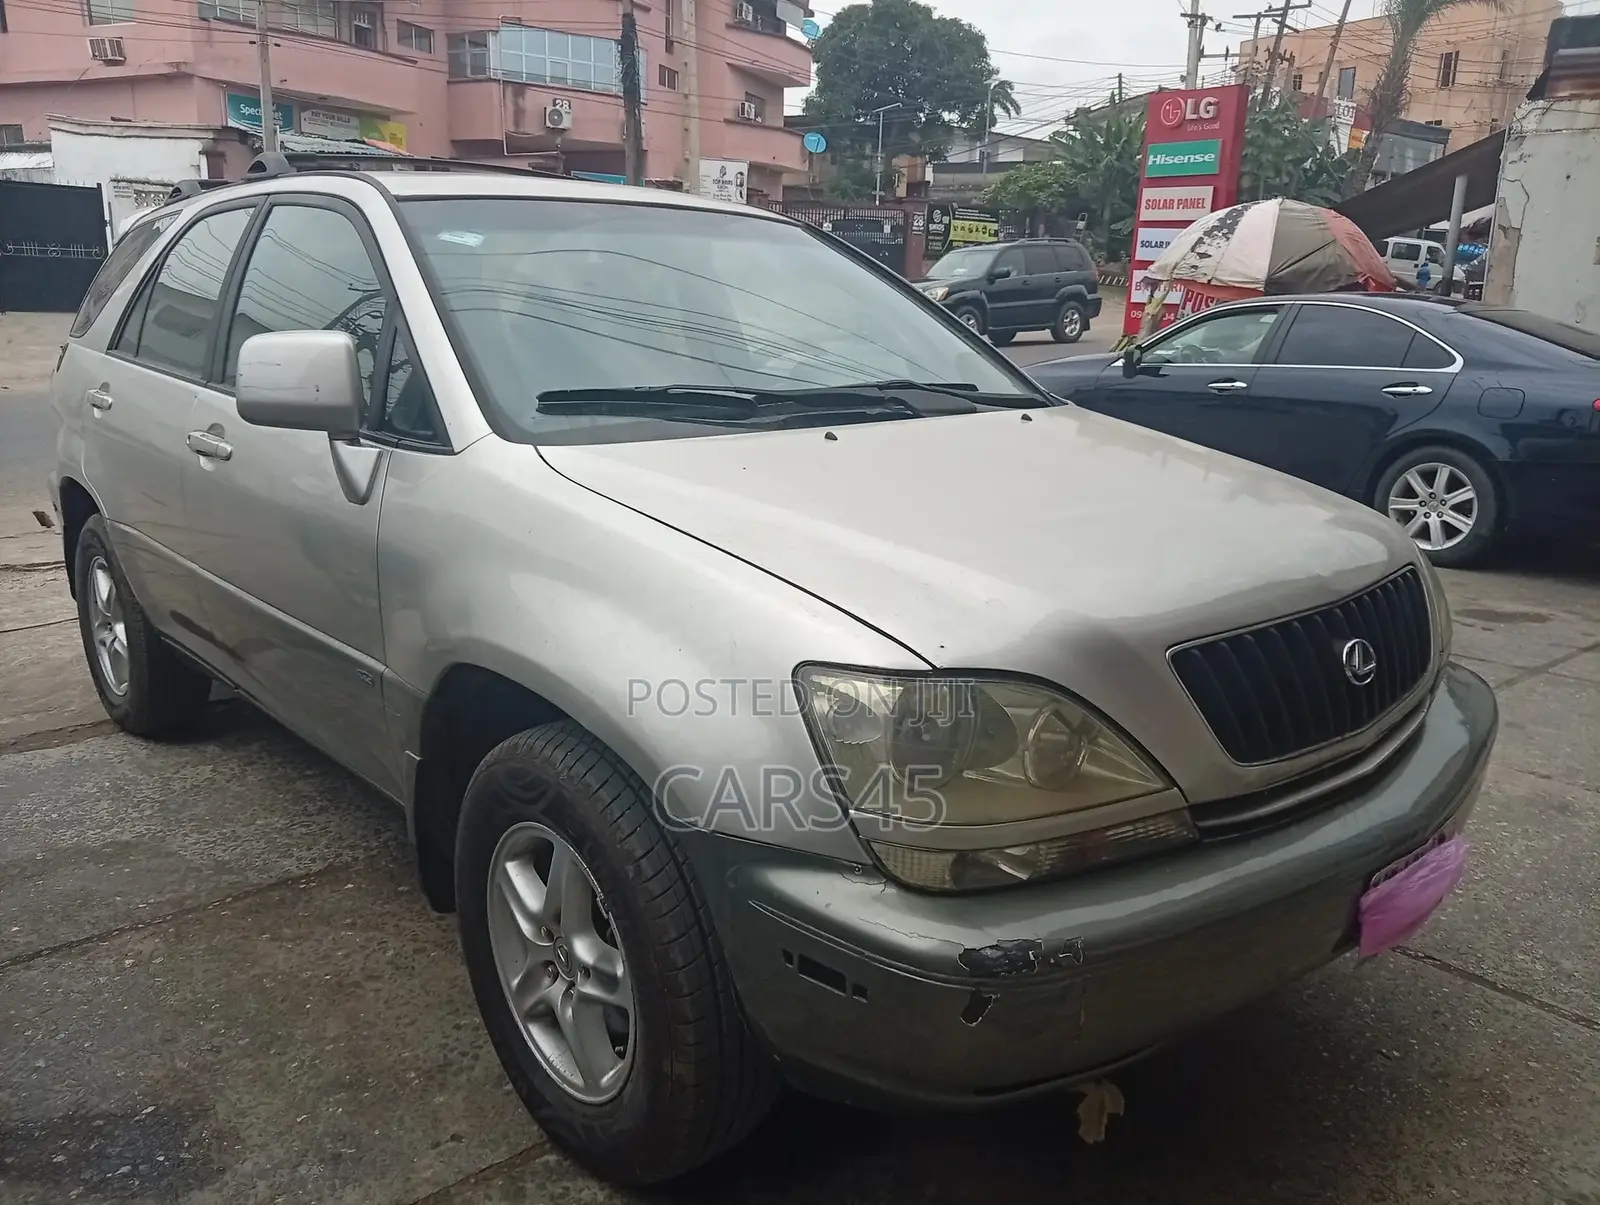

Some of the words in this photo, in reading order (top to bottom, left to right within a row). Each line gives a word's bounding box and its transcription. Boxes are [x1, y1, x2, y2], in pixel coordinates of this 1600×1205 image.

[555, 99, 570, 109] 28
[1185, 97, 1219, 120] LG
[1203, 121, 1220, 130] Good
[1148, 153, 1215, 166] Hisense
[1144, 198, 1175, 211] SOLAR
[1176, 197, 1206, 210] PANEL
[1140, 240, 1164, 249] SOLAR
